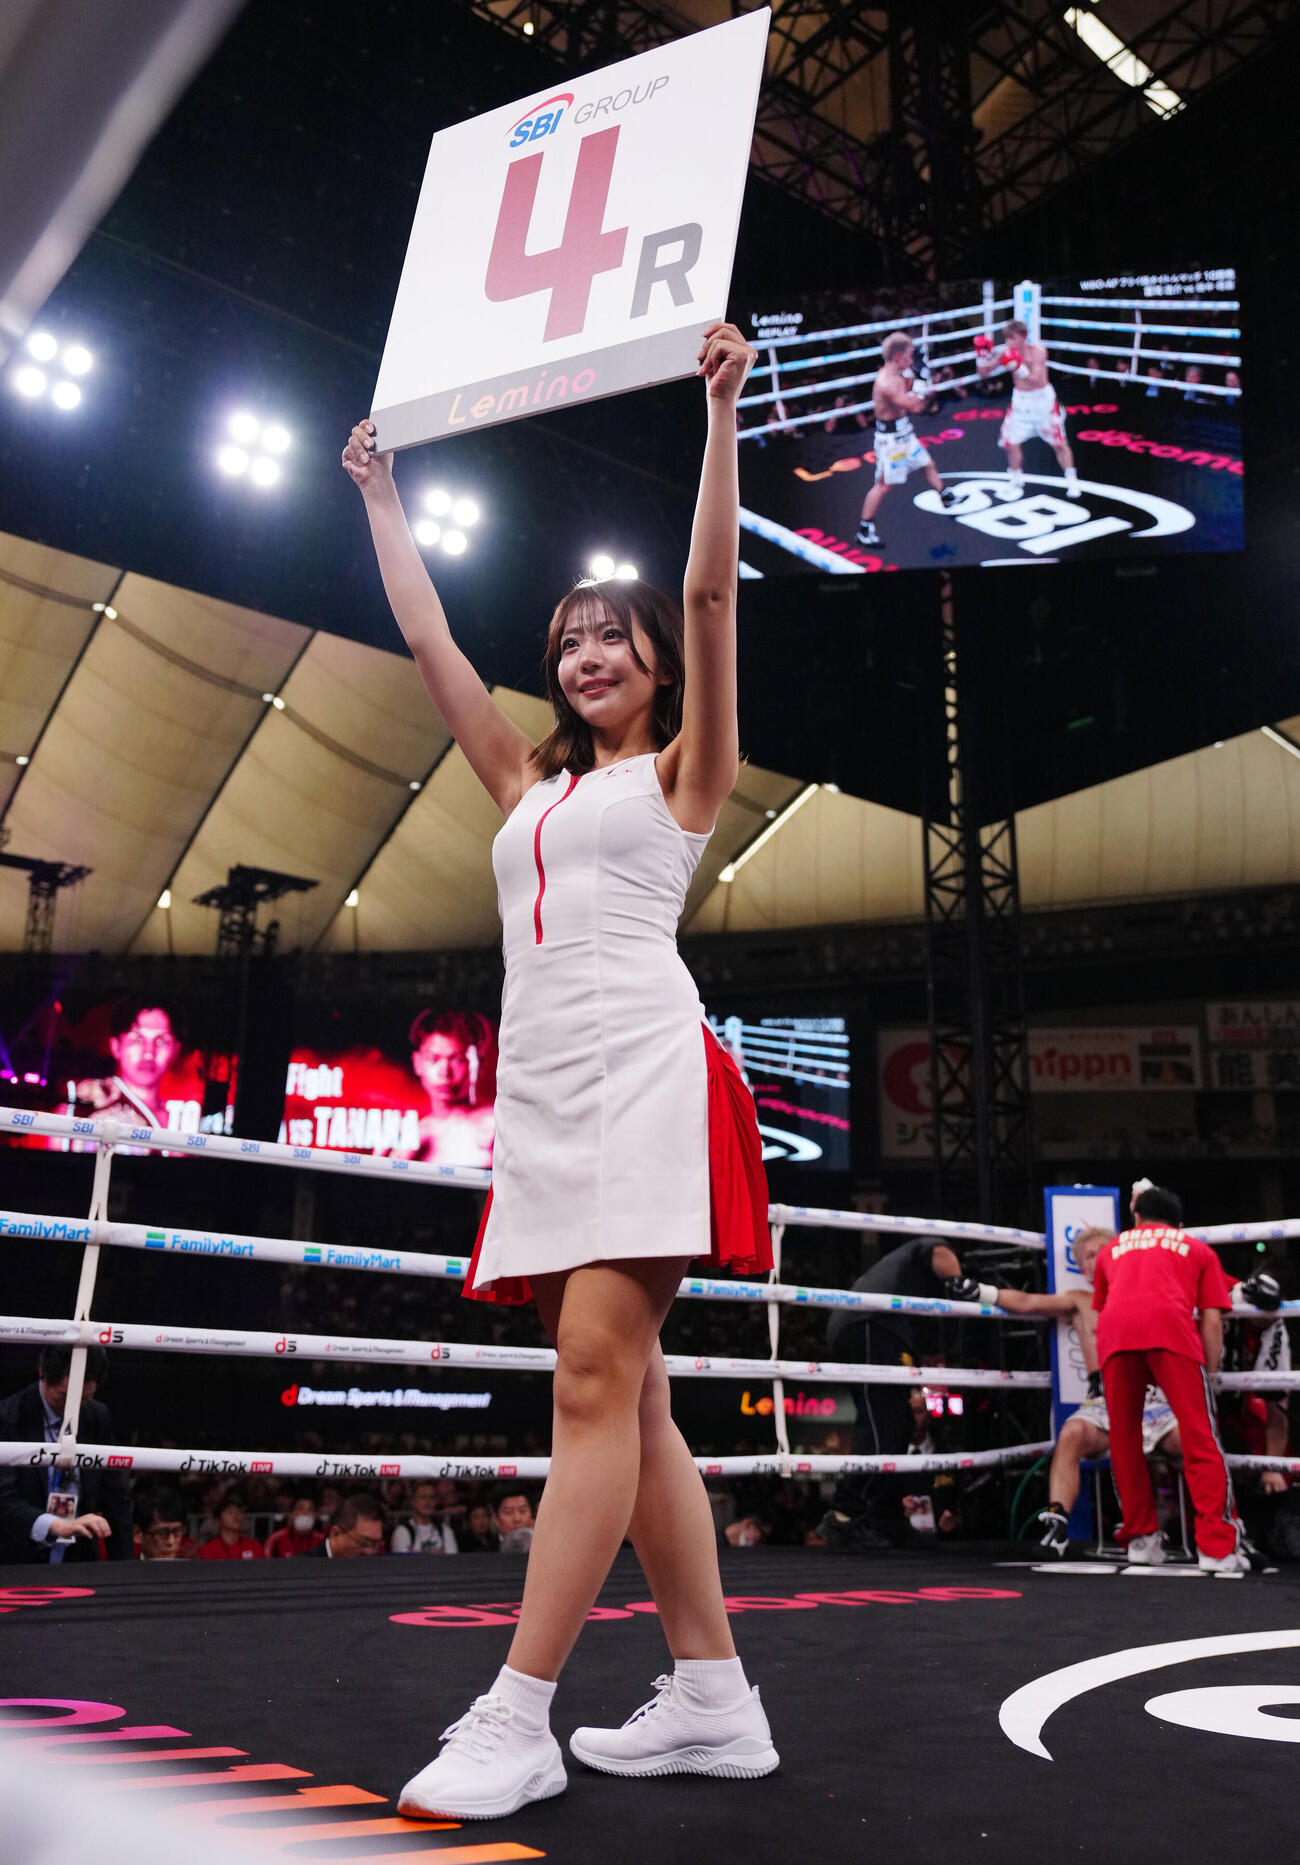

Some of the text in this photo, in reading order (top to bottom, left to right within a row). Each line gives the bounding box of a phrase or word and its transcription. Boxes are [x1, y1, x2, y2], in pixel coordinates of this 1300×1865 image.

[508, 74, 670, 149] SBI GROUP
[484, 124, 704, 344] 4 R
[751, 310, 804, 328] Lemino
[446, 366, 597, 426] Lemino
[913, 479, 1134, 555] SBI
[11, 1112, 37, 1127] SBI
[72, 1120, 95, 1134] SBI
[130, 1127, 153, 1141] SBI
[186, 1134, 207, 1148] SBI
[240, 1141, 260, 1153] SBI
[292, 1148, 312, 1159] SBI
[314, 1106, 421, 1150] TANAKA
[0, 1217, 402, 1269] FamilyMart FamilyMart FamilyMart
[707, 1282, 763, 1299] FamilyMart
[107, 1456, 133, 1468] LIVE
[198, 1459, 273, 1473] TikTok LIVE
[332, 1462, 377, 1477] TikTok
[455, 1464, 496, 1478] TikTok
